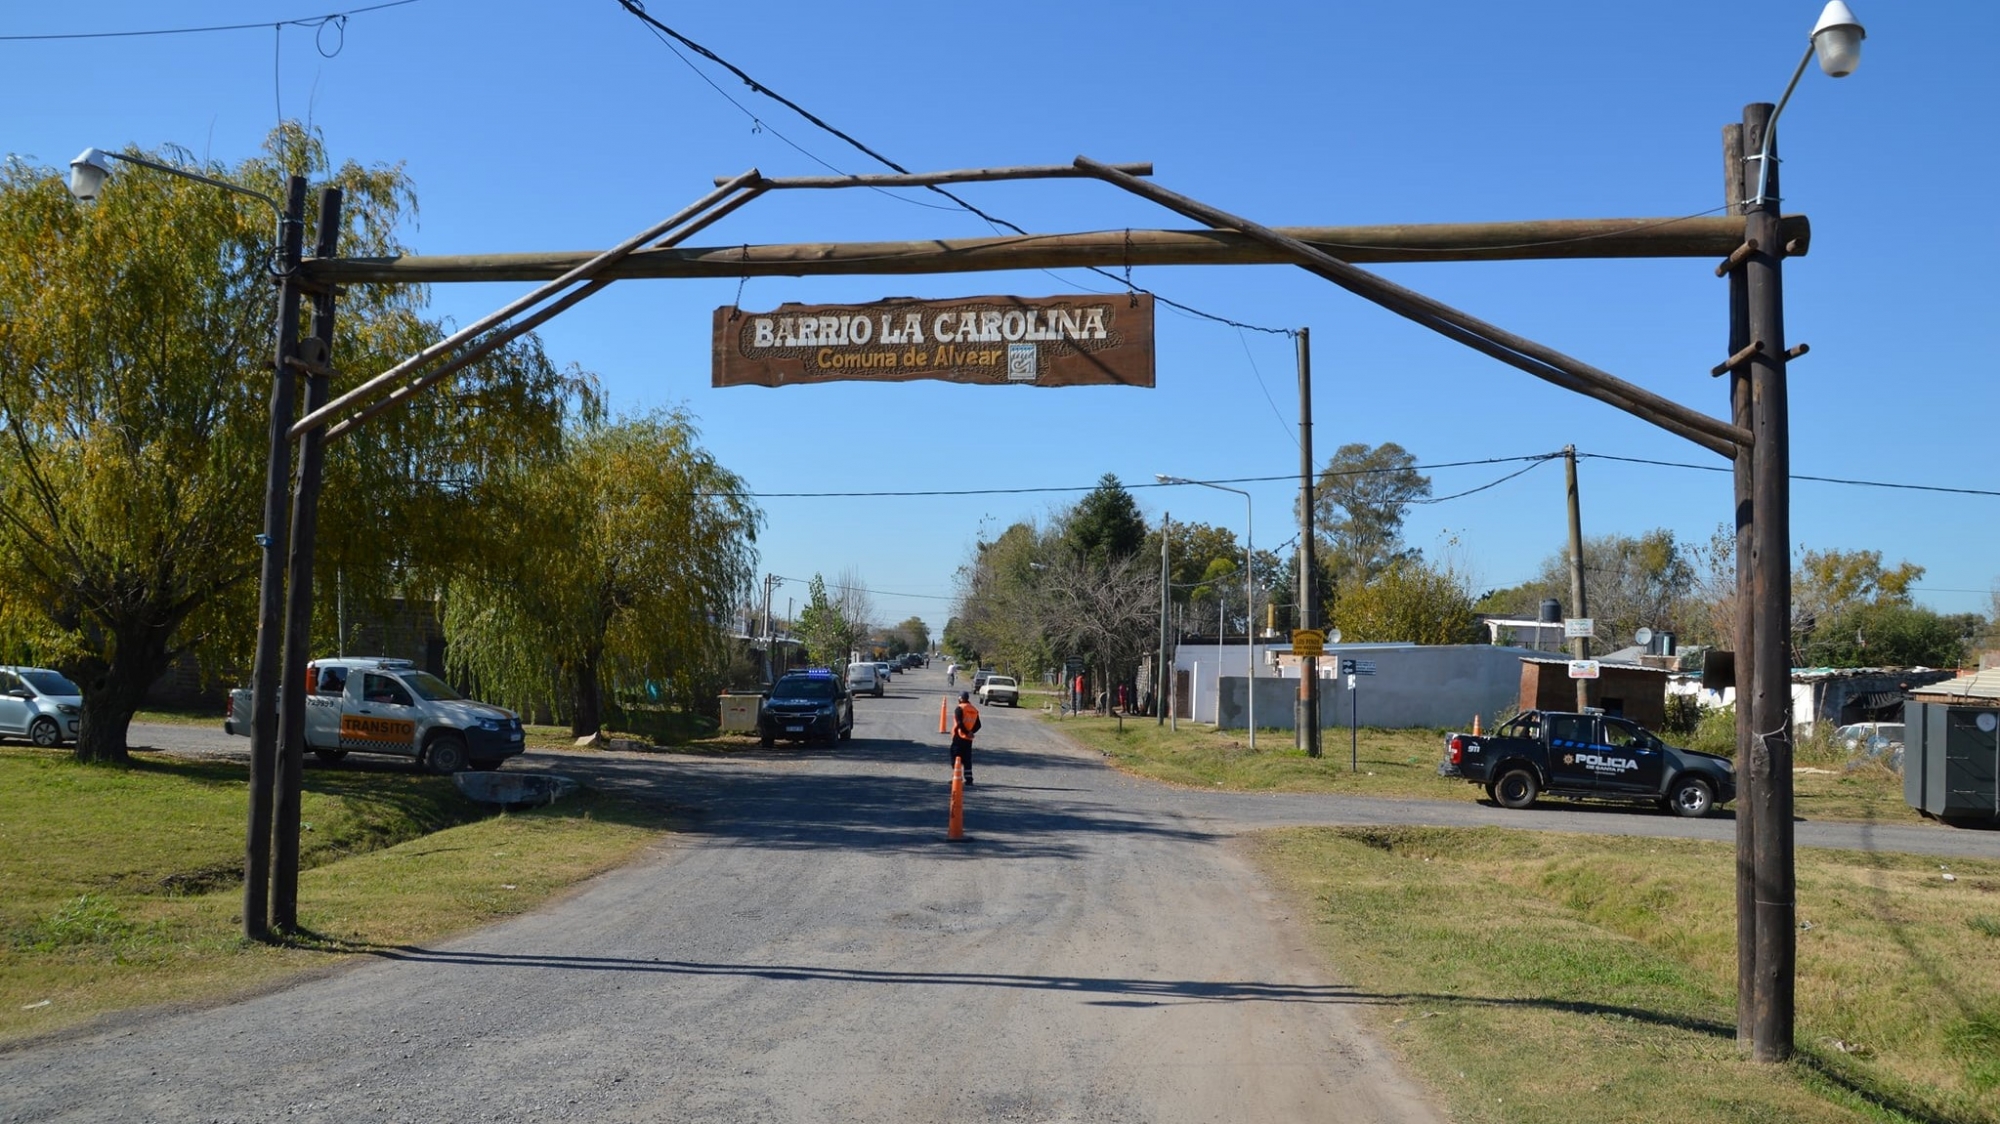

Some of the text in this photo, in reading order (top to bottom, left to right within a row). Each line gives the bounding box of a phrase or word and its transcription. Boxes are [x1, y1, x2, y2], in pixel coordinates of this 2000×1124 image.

[754, 308, 1107, 347] BARRIO LA CAROLINA
[817, 345, 1003, 368] Comuna de Alvear
[345, 719, 412, 735] TRANSITO
[1467, 745, 1480, 753] 911
[1575, 753, 1638, 770] POLICIA
